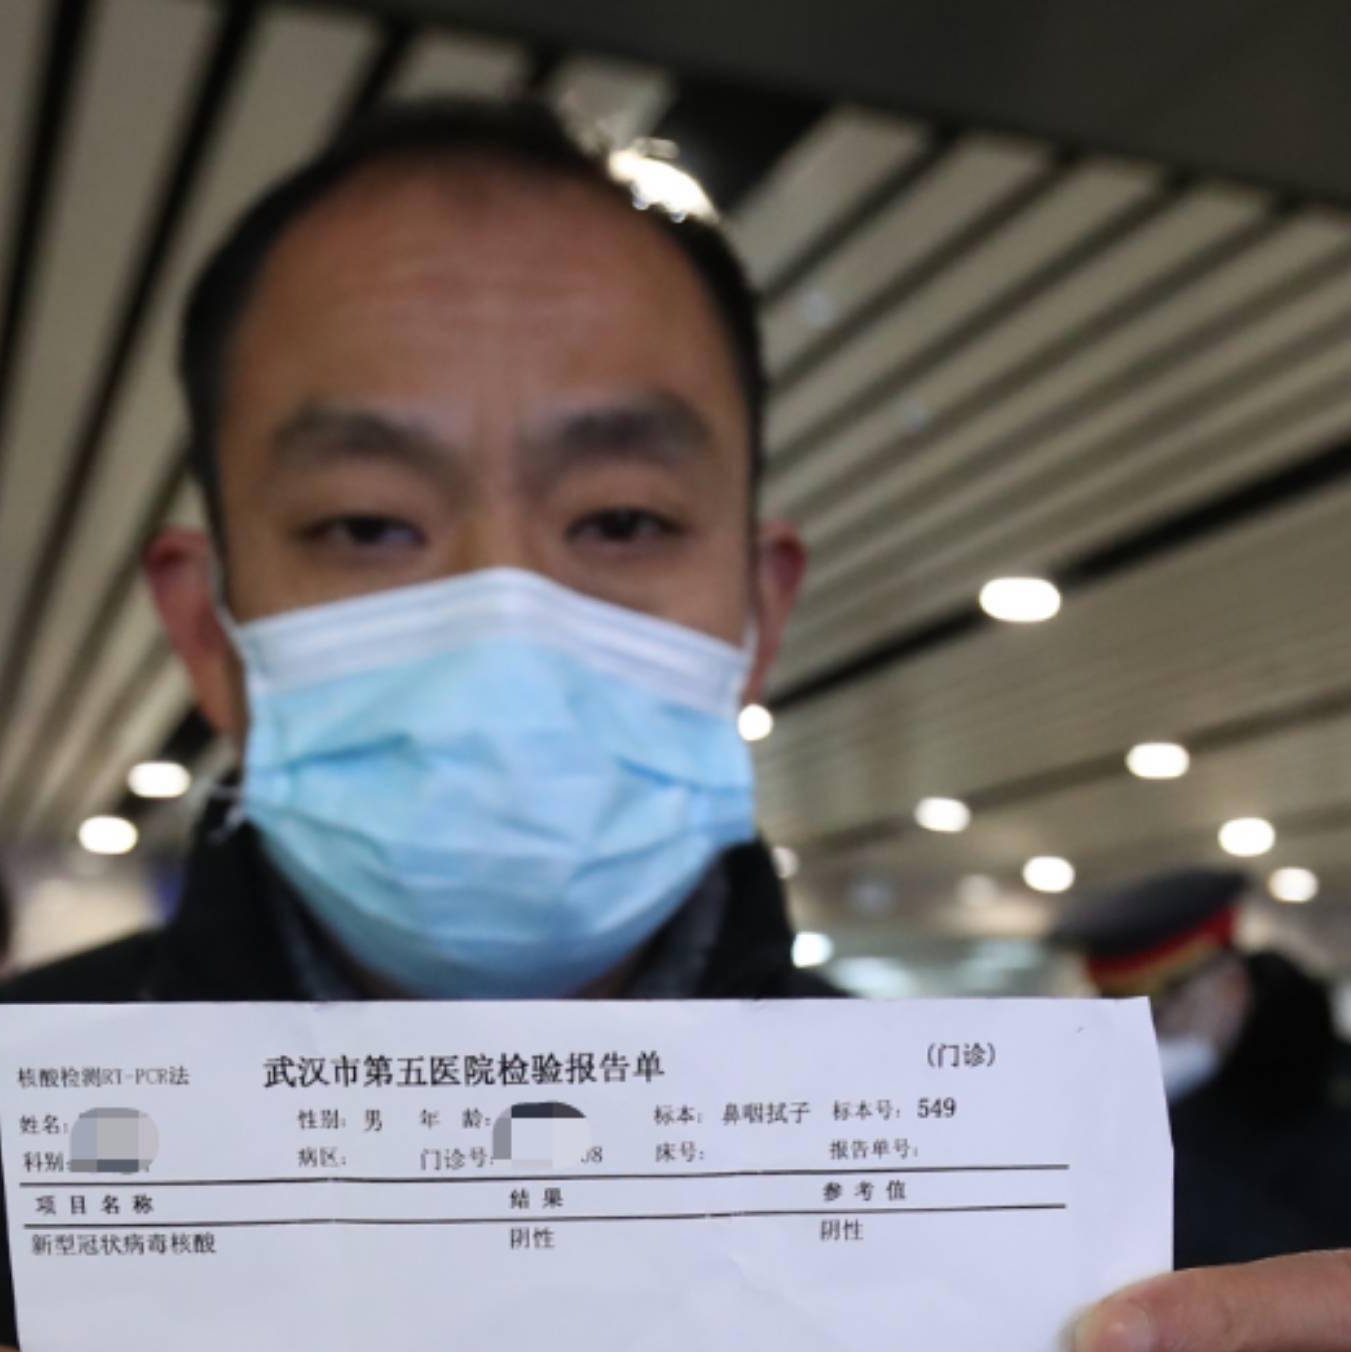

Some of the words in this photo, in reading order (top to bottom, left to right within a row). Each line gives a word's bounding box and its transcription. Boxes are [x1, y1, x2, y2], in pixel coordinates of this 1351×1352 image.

[263, 1051, 666, 1090] 武汉市第五医院检验报告单
[926, 1042, 997, 1069] (门诊)
[17, 1065, 190, 1089] 核酸检测RT-PCR法
[363, 1108, 384, 1133] 男
[722, 1100, 812, 1126] 鼻咽拭子
[916, 1096, 958, 1120] 549
[35, 1194, 154, 1216] 项目名称
[509, 1187, 564, 1210] 结果
[822, 1179, 907, 1202] 参考值
[31, 1233, 217, 1257] 新型冠状病毒核酸
[510, 1226, 556, 1250] 阴性
[819, 1219, 864, 1242] 阴性
